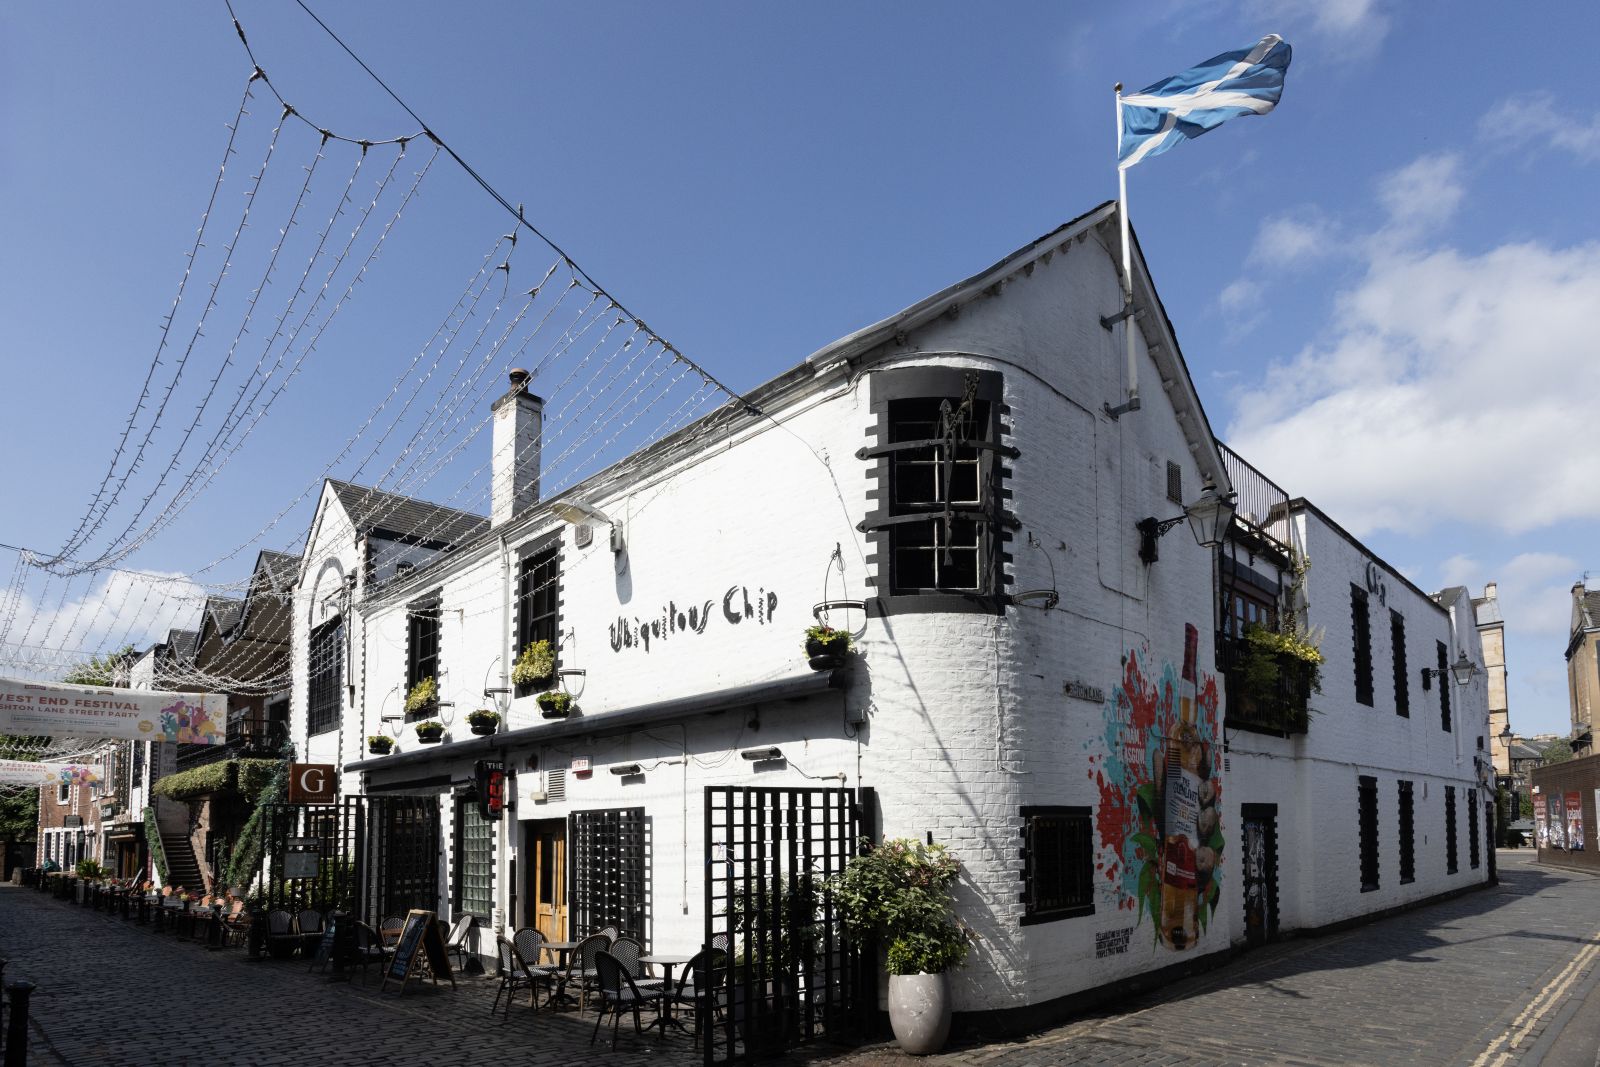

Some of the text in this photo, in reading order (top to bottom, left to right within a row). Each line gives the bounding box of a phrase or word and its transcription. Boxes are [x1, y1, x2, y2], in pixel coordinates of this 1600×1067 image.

[608, 585, 779, 654] Ubiquitous Chip
[0, 703, 141, 719] SHTON LANE STREET PARTY
[39, 696, 69, 707] END
[75, 699, 141, 711] FESTIVAL
[486, 762, 504, 770] THE
[300, 768, 325, 793] G
